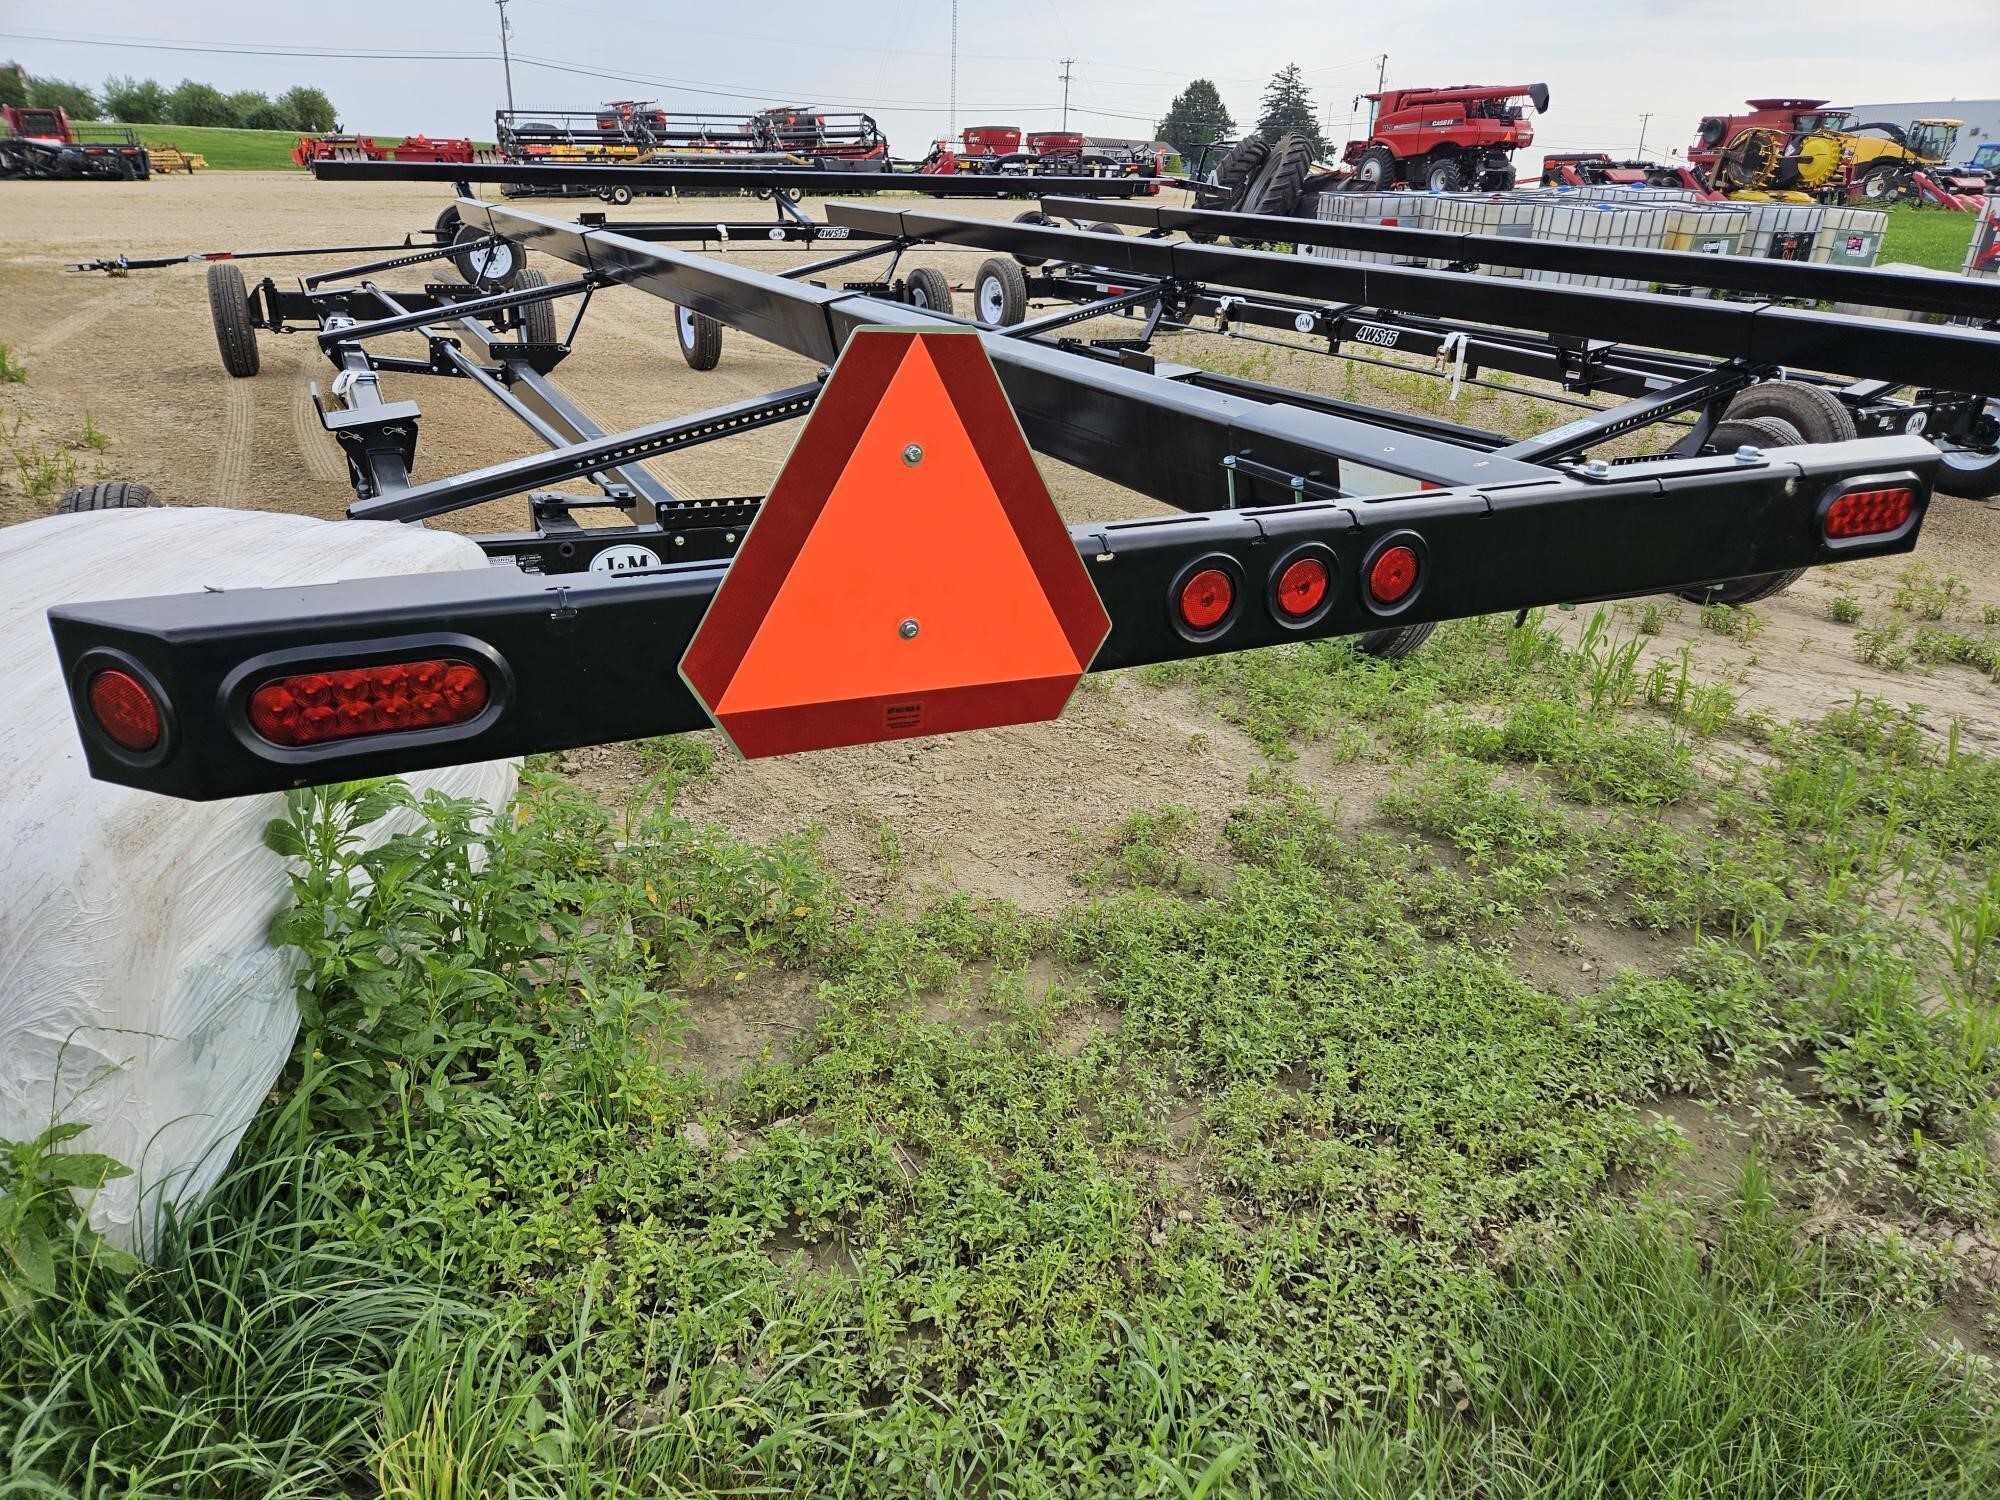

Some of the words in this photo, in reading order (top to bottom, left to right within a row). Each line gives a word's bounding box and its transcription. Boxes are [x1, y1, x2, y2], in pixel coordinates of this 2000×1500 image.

[818, 228, 849, 239] 4WS15
[1298, 317, 1311, 329] J&M
[1356, 326, 1399, 346] 4WS15
[1907, 417, 1925, 431] J&M
